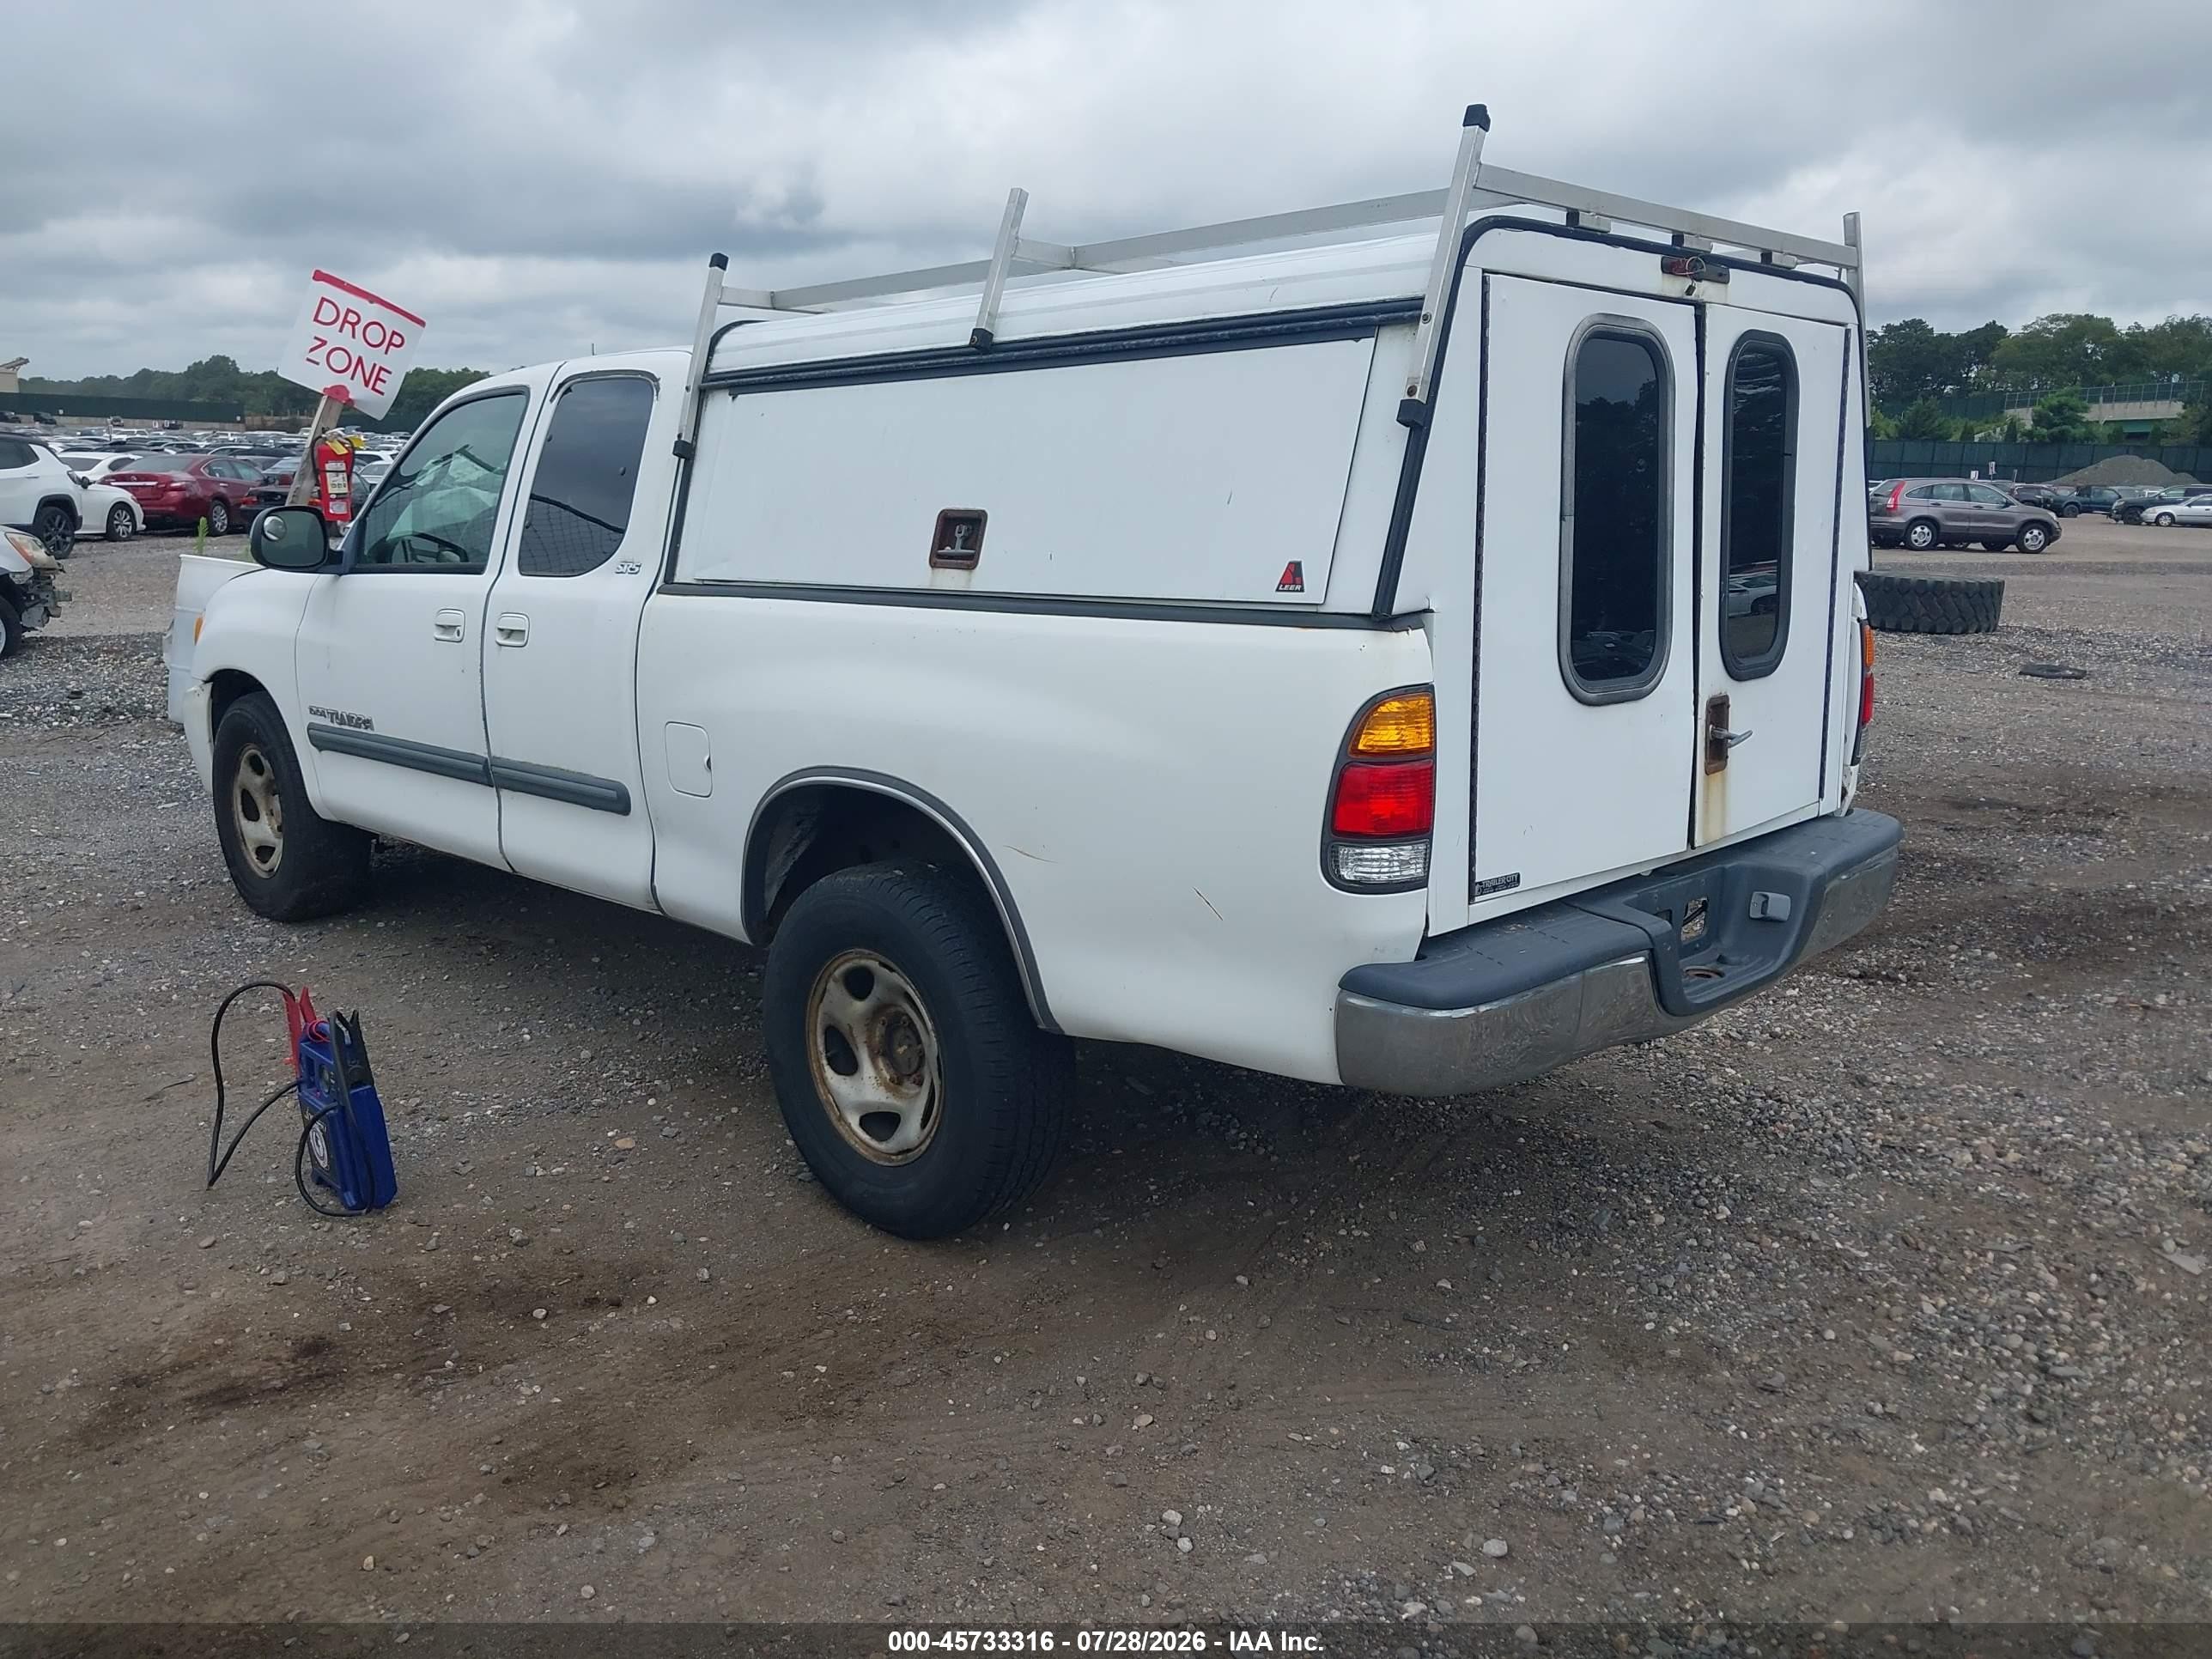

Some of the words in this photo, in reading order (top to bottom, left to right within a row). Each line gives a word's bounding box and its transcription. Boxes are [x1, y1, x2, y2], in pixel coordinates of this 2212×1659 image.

[313, 296, 405, 356] DROP
[306, 336, 392, 397] ZONE
[1482, 877, 1506, 889] TRAILER
[1506, 873, 1518, 884] CITY
